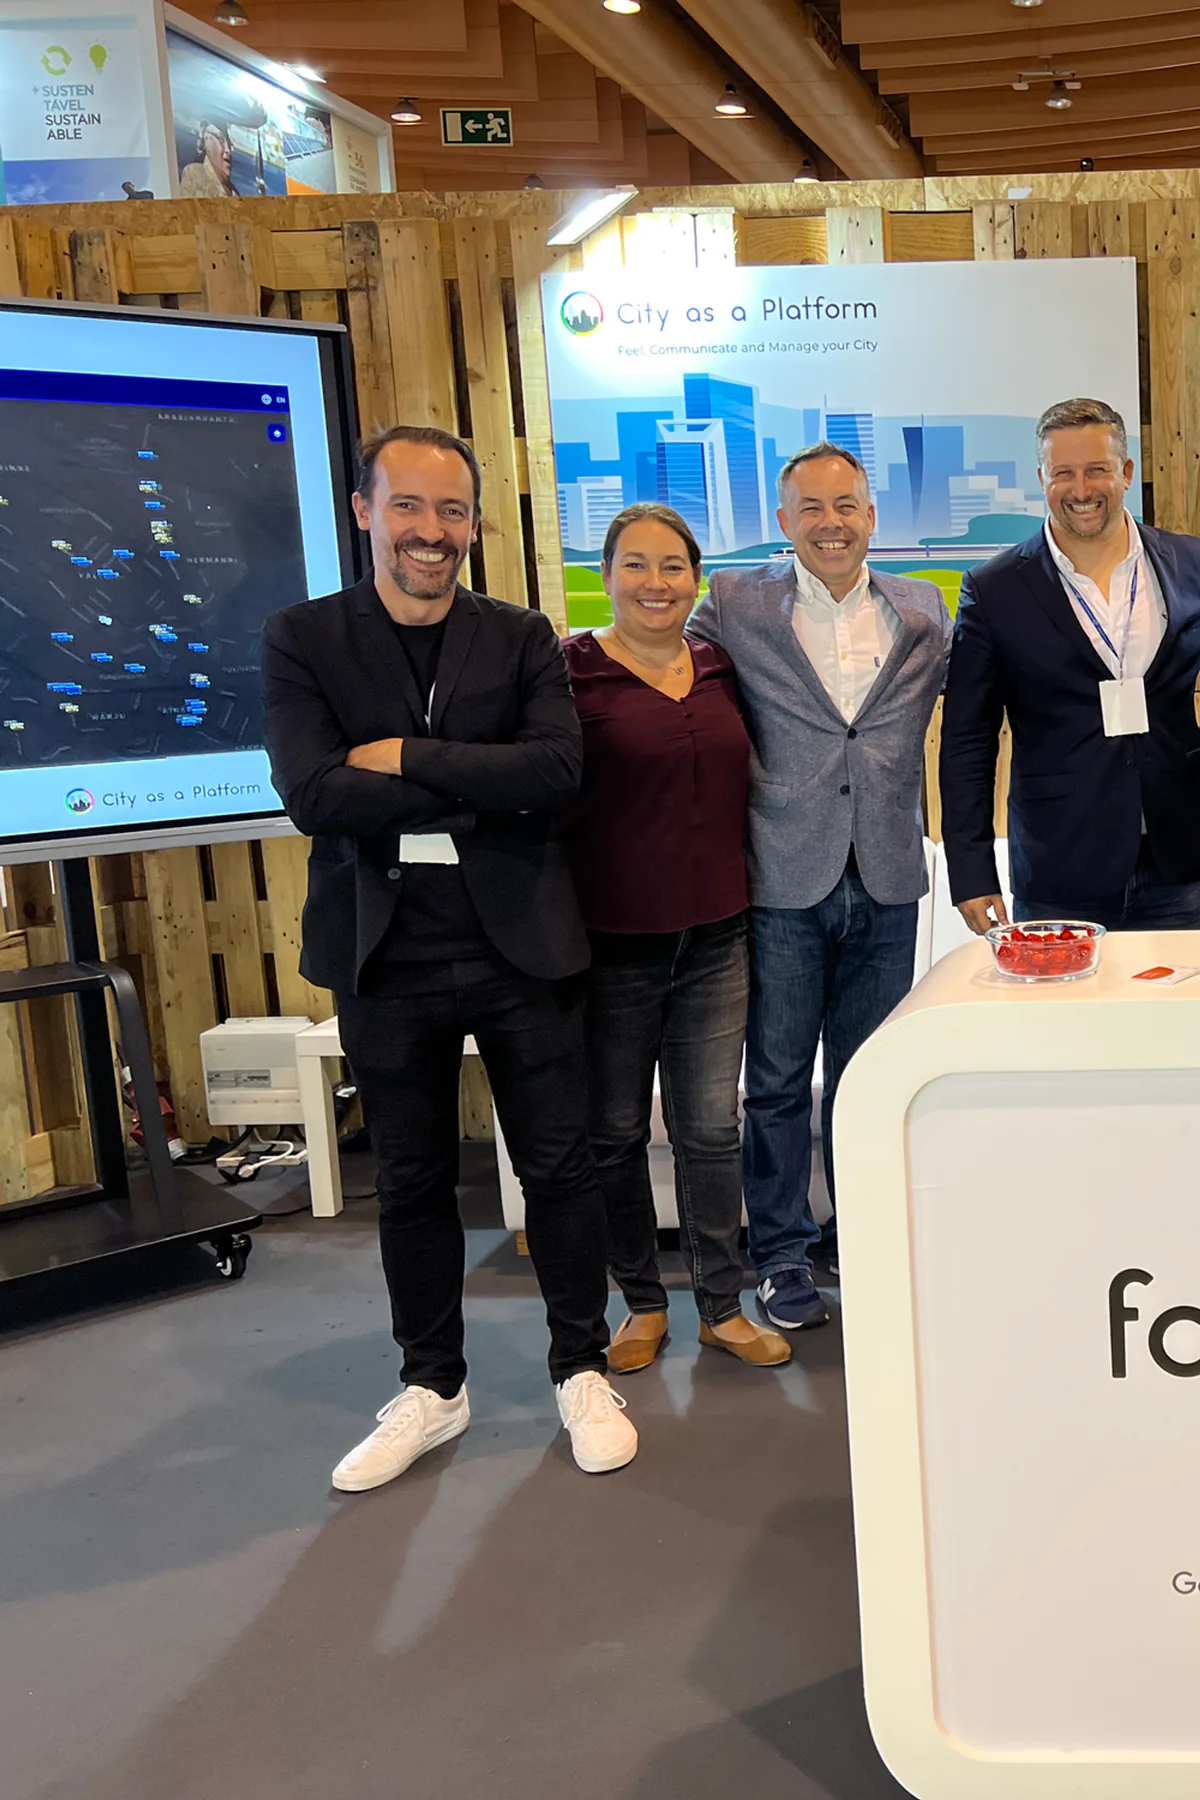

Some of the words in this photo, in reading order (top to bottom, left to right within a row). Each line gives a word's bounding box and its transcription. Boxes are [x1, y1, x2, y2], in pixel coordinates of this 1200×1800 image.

[41, 84, 94, 97] SUSTEN
[43, 98, 86, 111] TÁVEL
[45, 113, 101, 126] SUSTAIN
[46, 128, 83, 141] ABLE
[617, 301, 669, 332] City
[686, 307, 714, 322] as
[731, 306, 746, 321] a
[763, 296, 877, 321] Platform
[649, 343, 738, 355] Communicate
[741, 342, 765, 353] and
[768, 342, 819, 354] Manage
[822, 341, 850, 354] your
[853, 339, 878, 352] City
[102, 791, 137, 809] City
[146, 792, 165, 802] as
[174, 790, 184, 800] a
[193, 783, 261, 799] Platform
